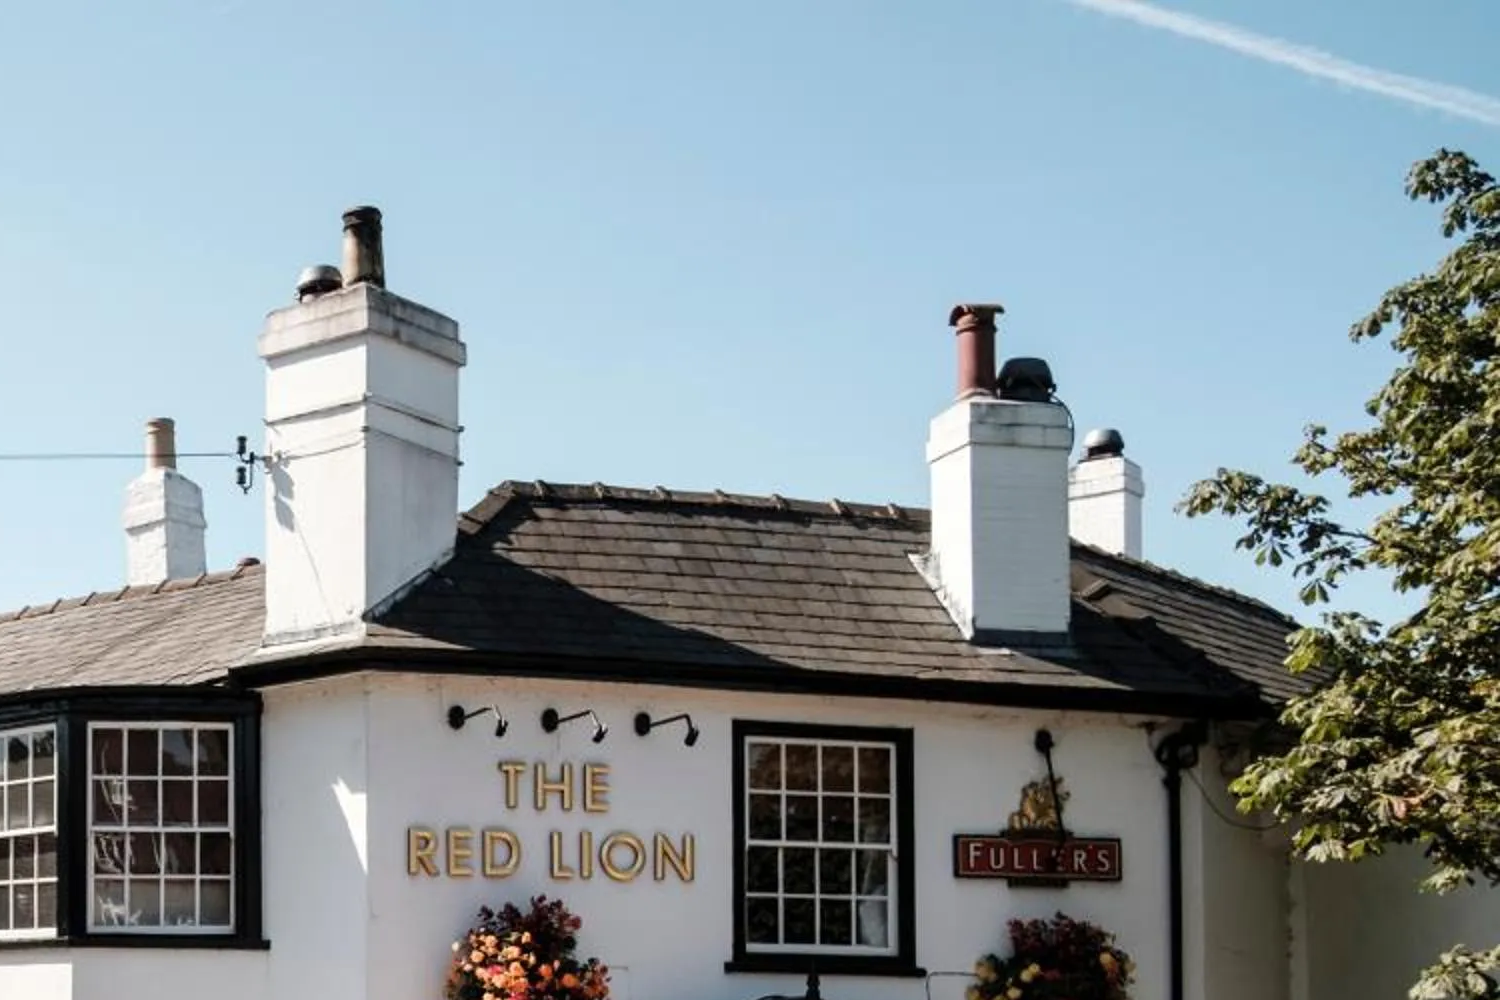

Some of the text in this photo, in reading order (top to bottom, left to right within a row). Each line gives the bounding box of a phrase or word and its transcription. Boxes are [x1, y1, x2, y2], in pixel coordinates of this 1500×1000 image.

[498, 760, 611, 812] THE
[406, 826, 695, 882] RED LION
